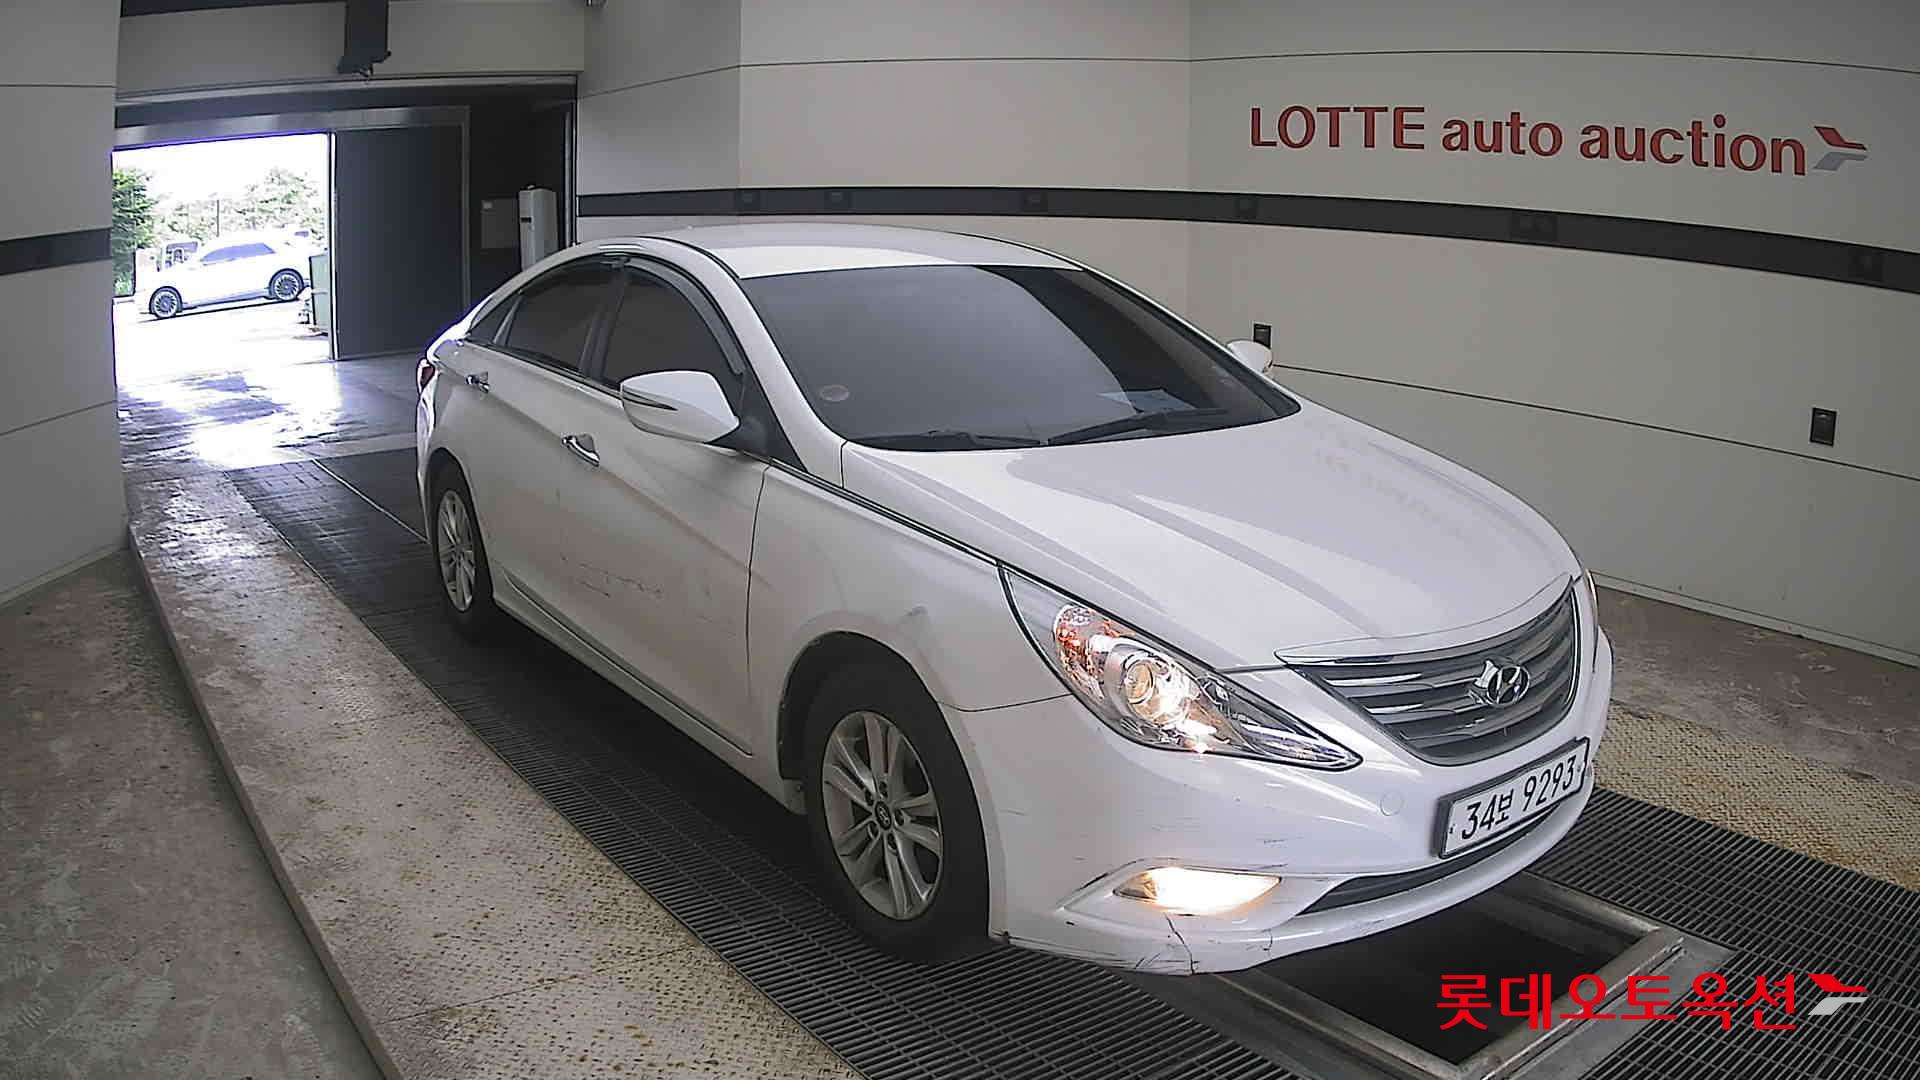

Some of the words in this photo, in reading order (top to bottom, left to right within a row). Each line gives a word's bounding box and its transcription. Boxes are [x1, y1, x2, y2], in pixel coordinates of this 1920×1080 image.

[1250, 106, 1425, 150] LOTTE
[1441, 111, 1563, 157] auto
[1578, 114, 1806, 176] auction
[1461, 788, 1514, 839] 34보
[1522, 755, 1577, 812] 9293
